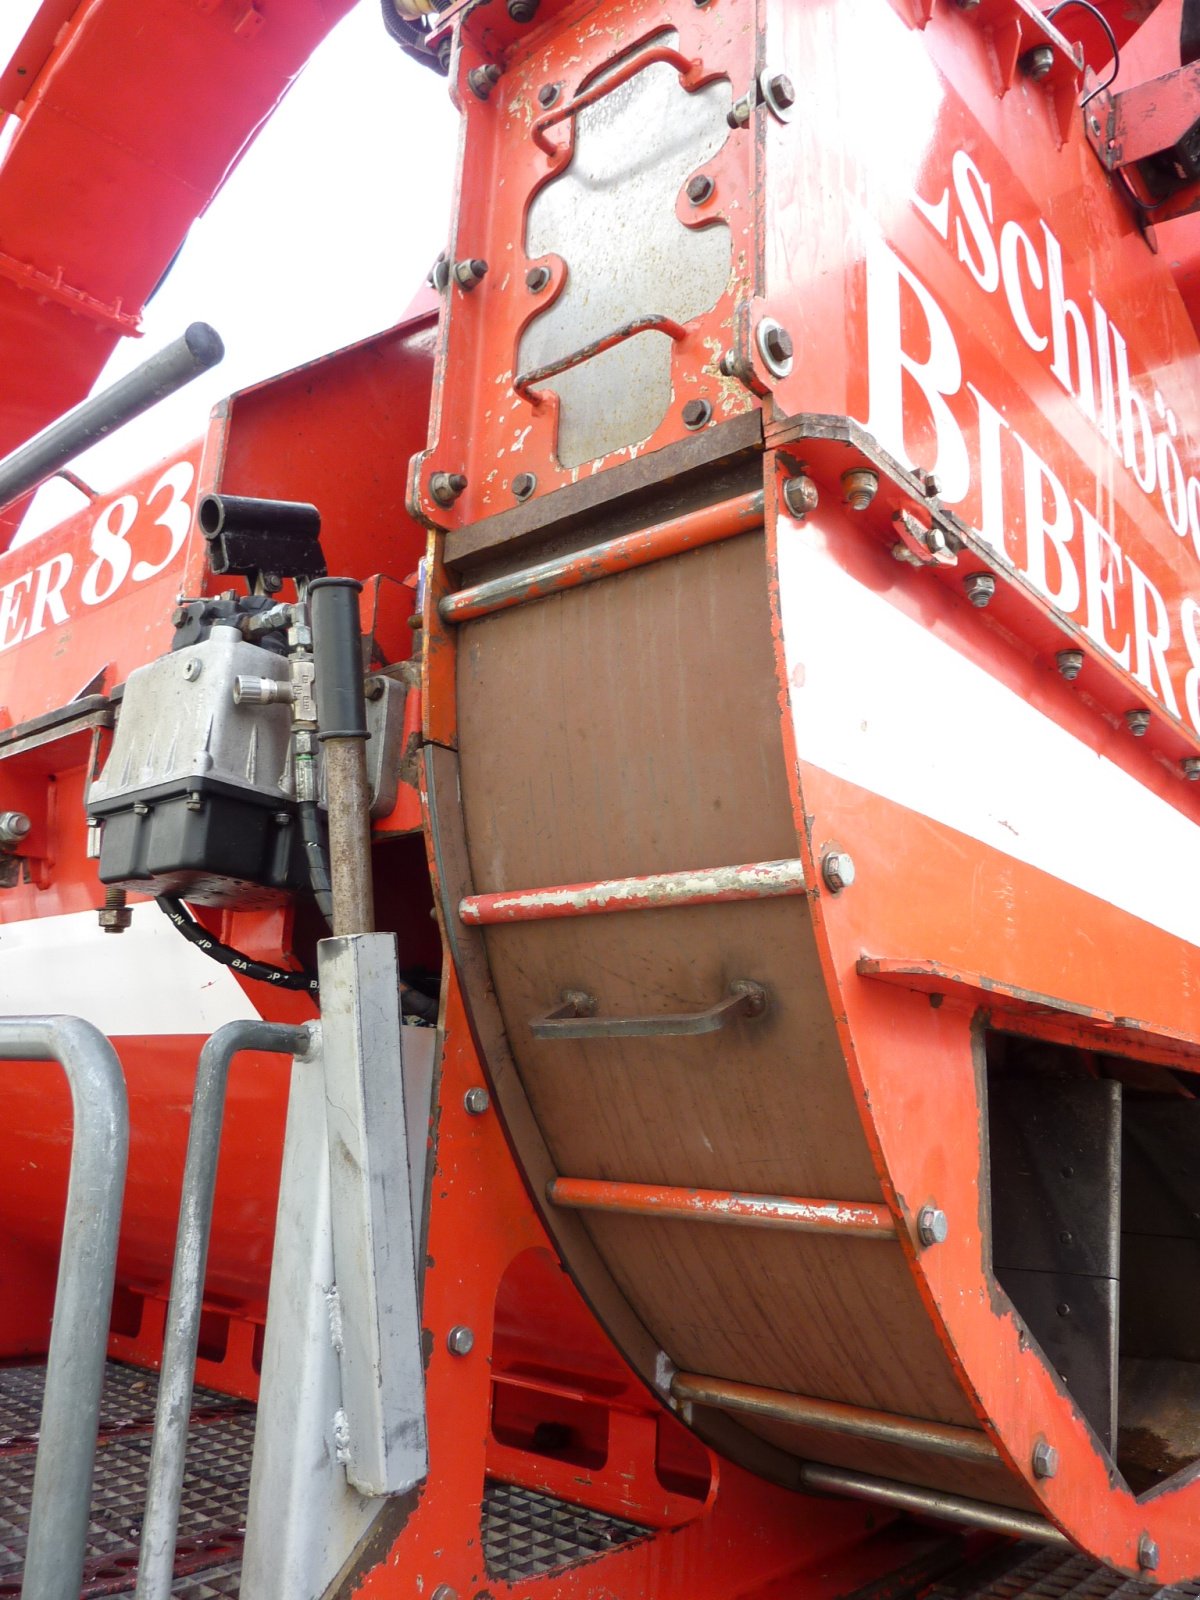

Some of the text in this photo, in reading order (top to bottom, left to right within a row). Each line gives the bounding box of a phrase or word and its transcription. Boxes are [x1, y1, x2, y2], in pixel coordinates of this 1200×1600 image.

[0, 461, 194, 651] ER 83
[848, 208, 1182, 721] BIBER
